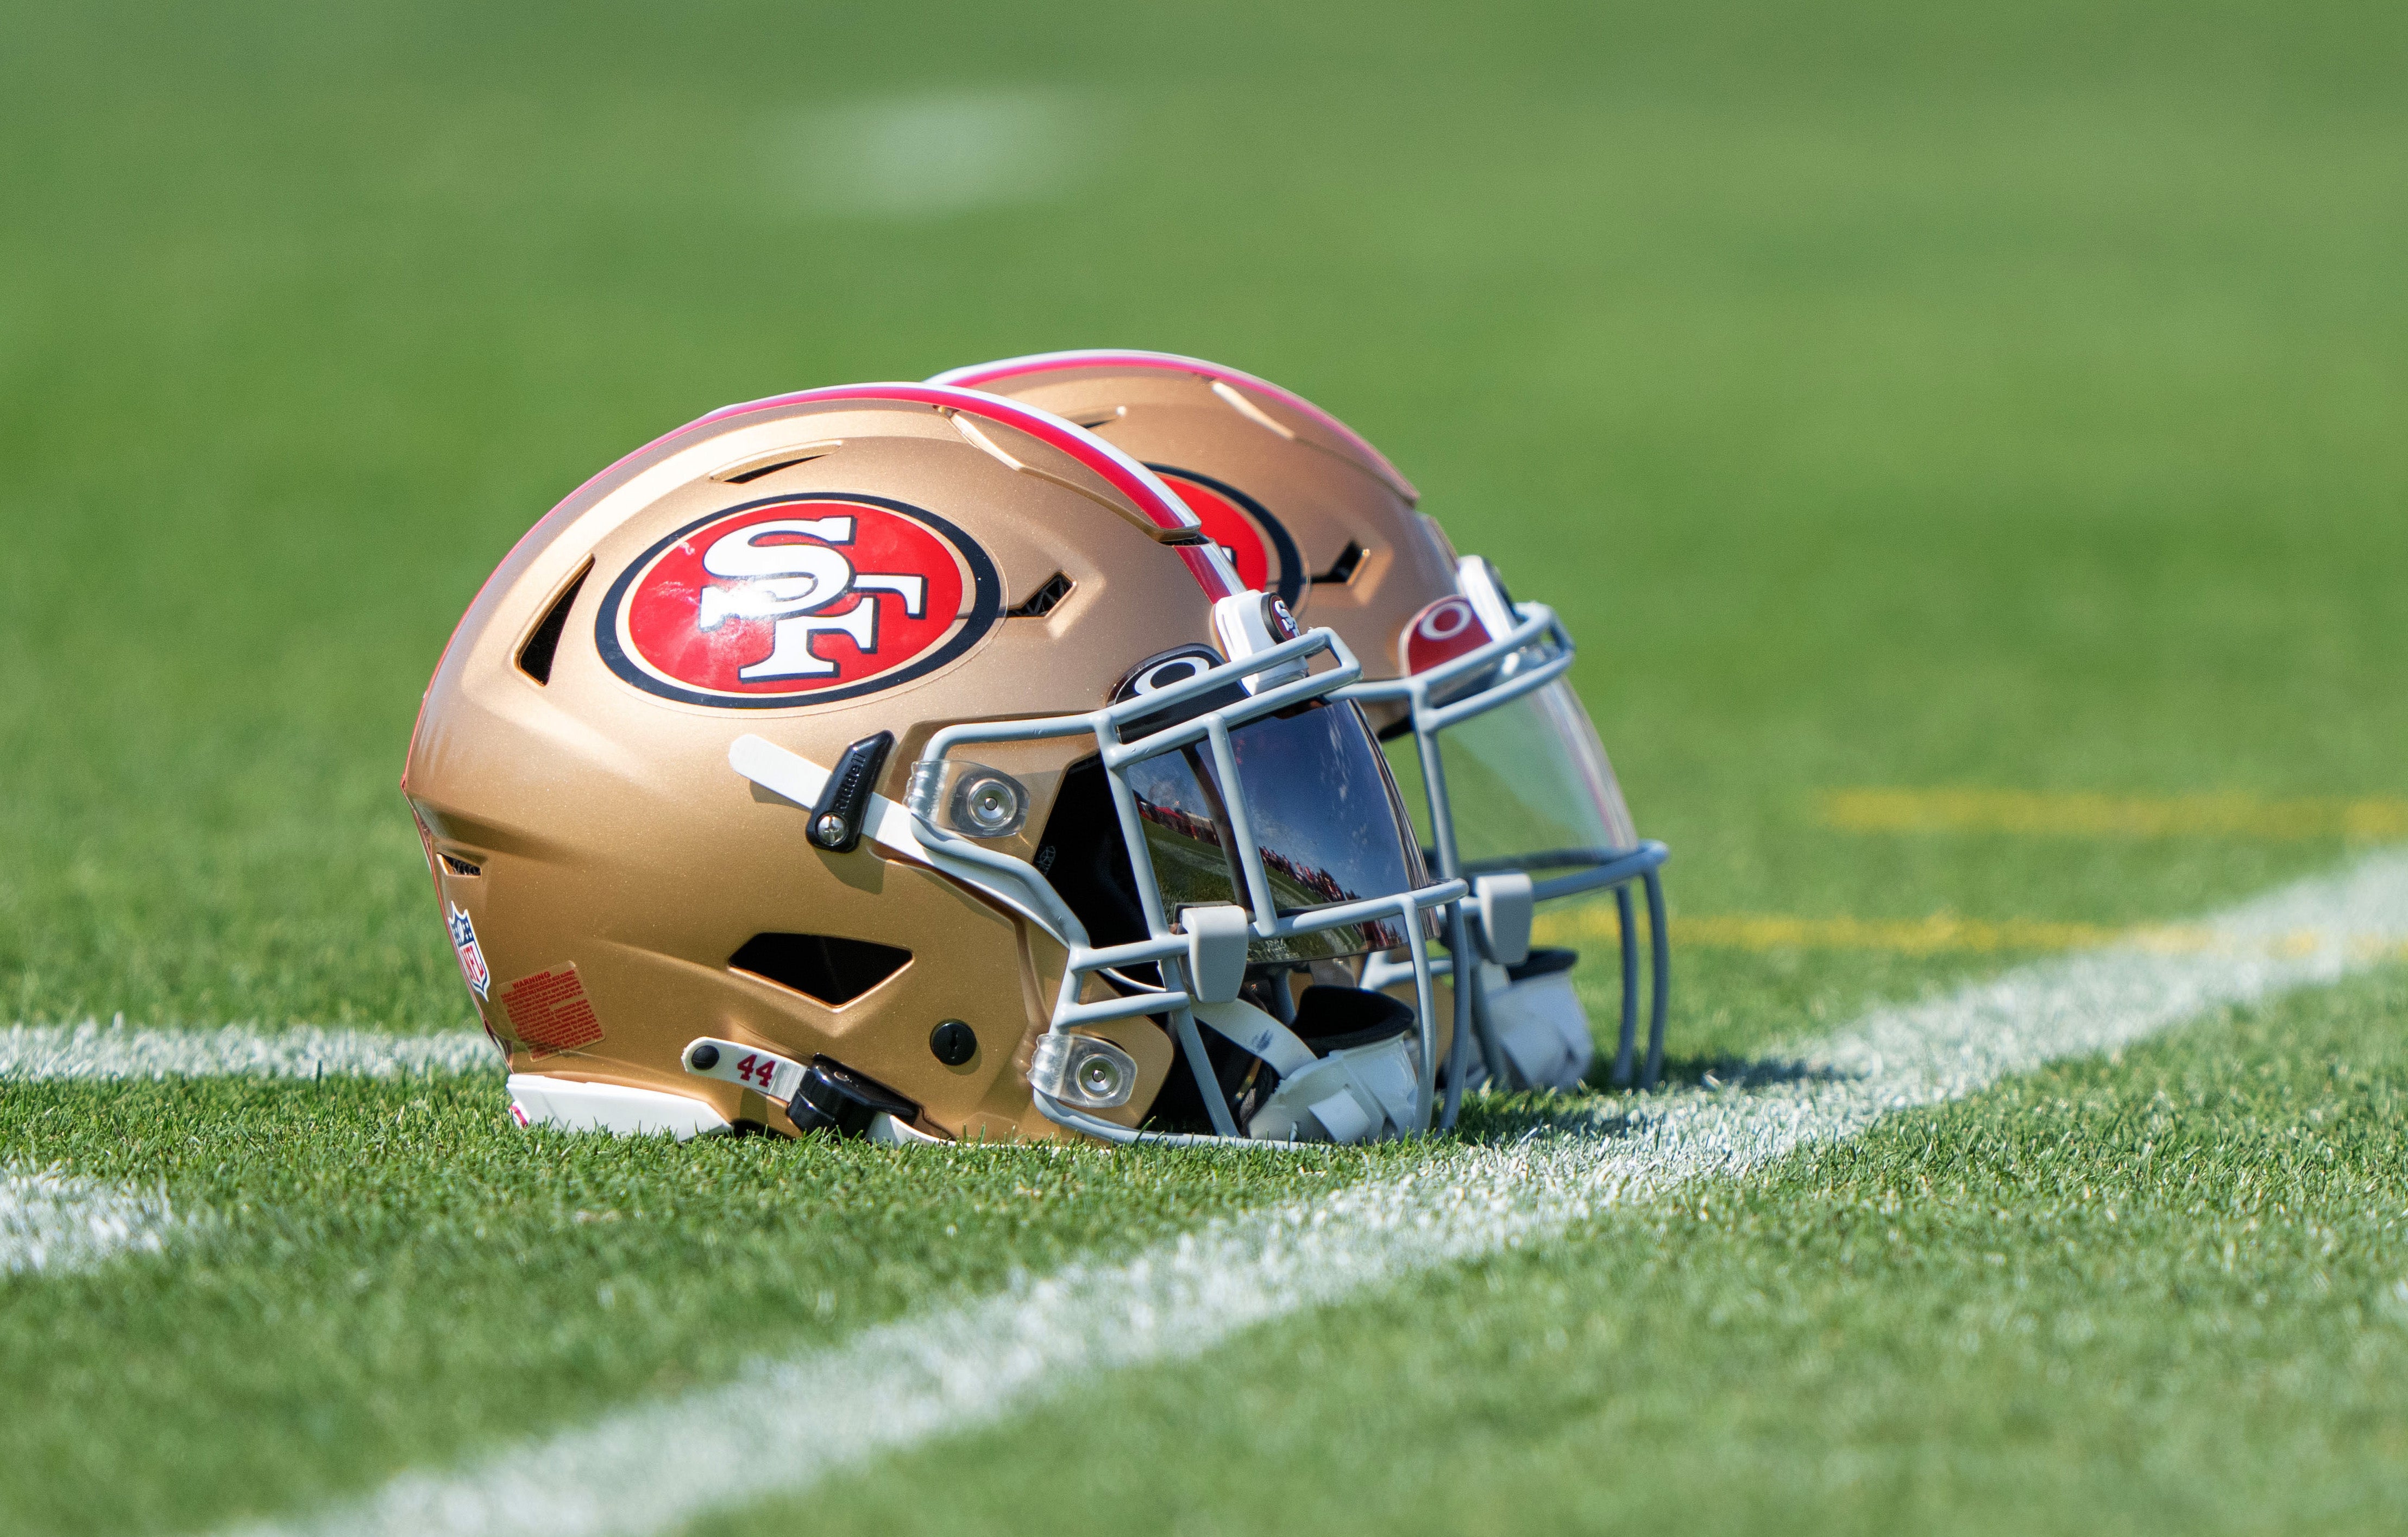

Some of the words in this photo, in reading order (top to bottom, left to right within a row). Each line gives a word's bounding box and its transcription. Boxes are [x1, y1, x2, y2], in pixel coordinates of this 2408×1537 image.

[699, 515, 929, 683] SF
[461, 945, 484, 983] NFL
[512, 971, 551, 989] WARNING
[737, 1054, 776, 1087] 44
